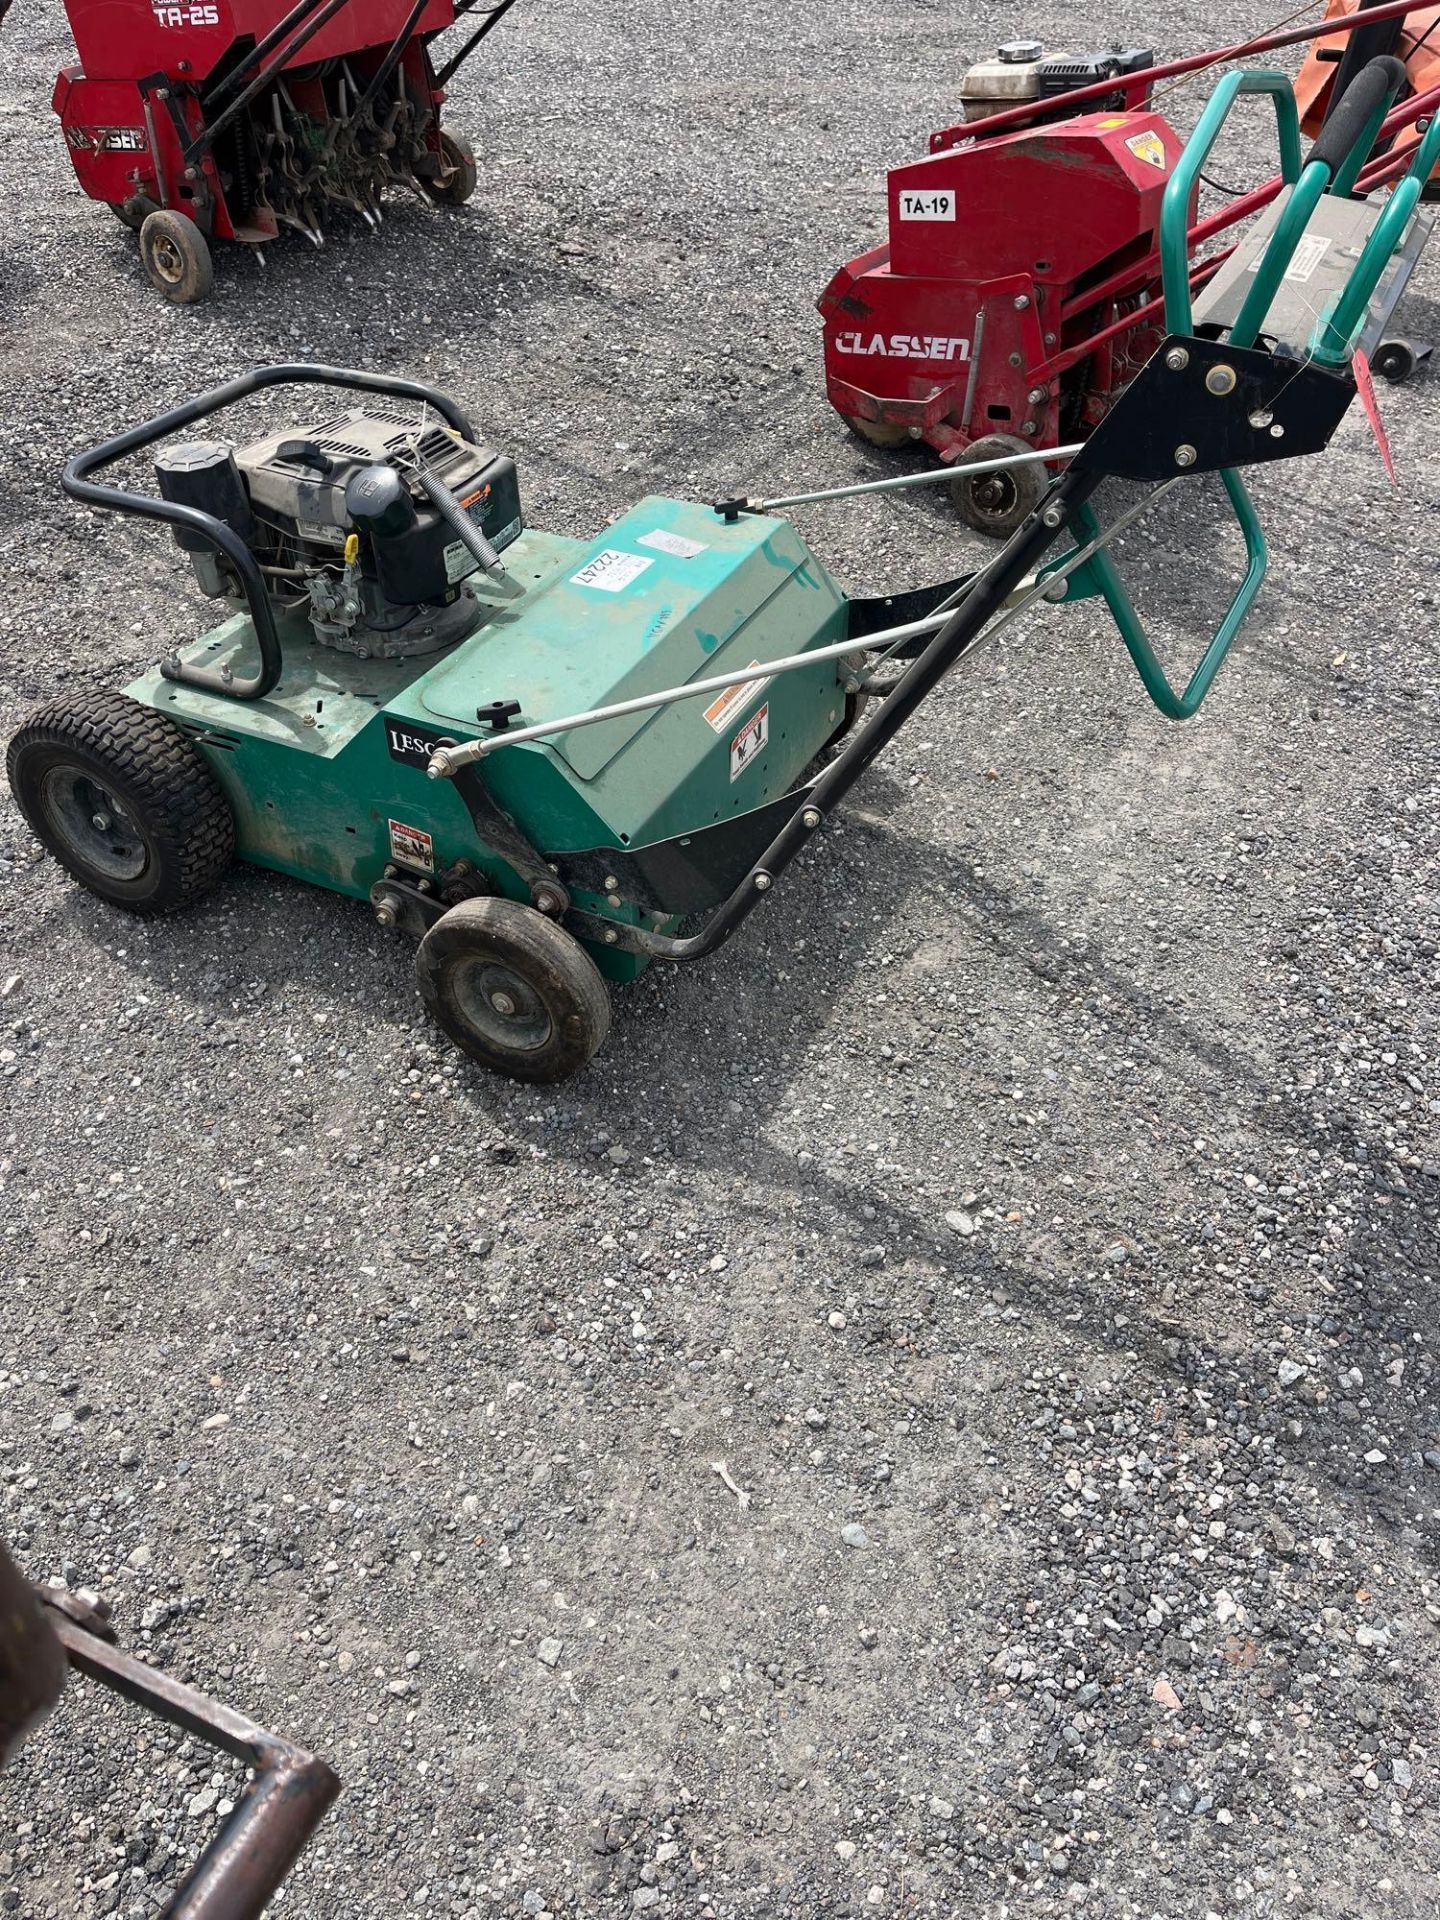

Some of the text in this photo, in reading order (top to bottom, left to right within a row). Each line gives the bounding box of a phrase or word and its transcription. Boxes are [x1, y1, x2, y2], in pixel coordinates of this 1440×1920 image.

[153, 5, 219, 27] TA-25
[904, 196, 949, 214] TA-19
[835, 332, 970, 361] CLASSEN
[577, 552, 619, 583] 22247
[390, 729, 436, 757] LESC
